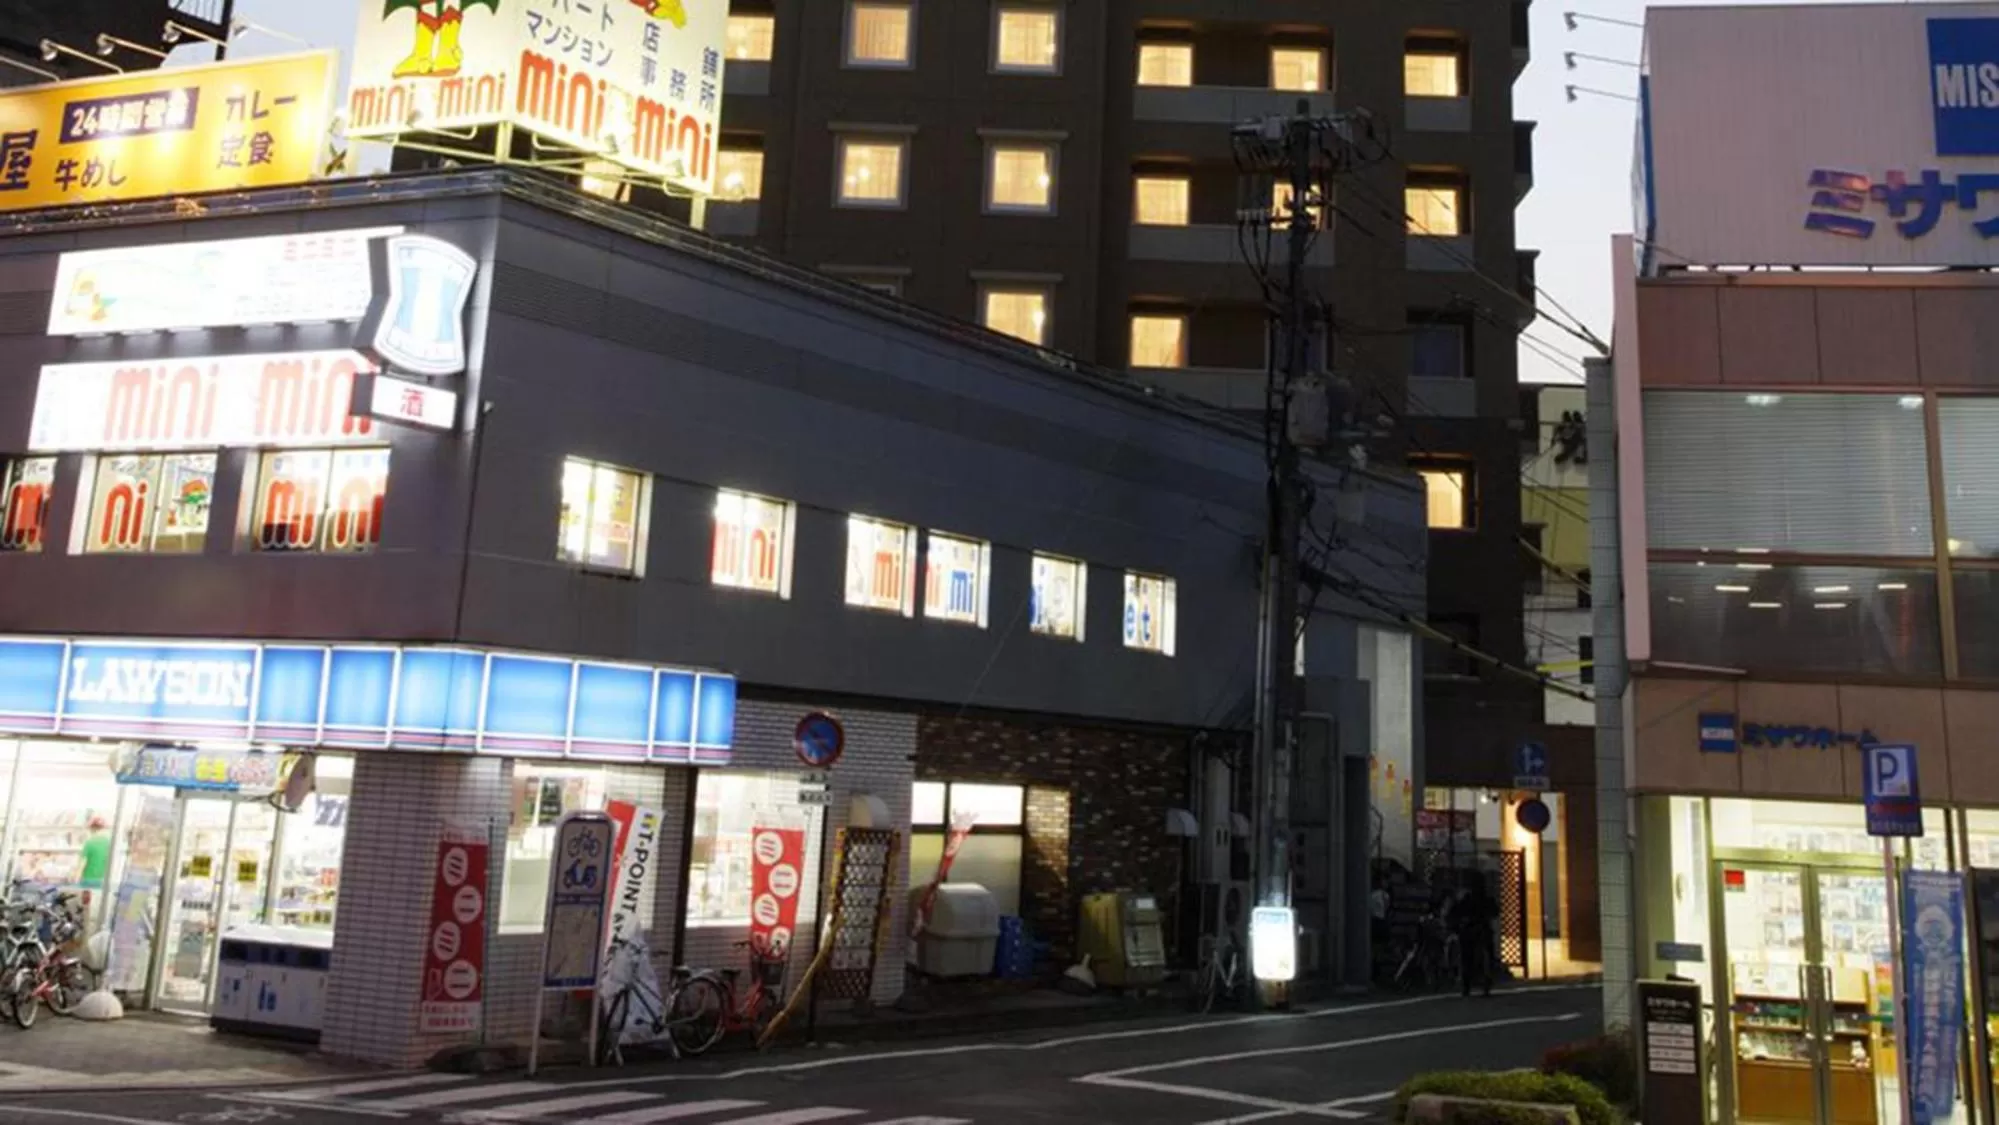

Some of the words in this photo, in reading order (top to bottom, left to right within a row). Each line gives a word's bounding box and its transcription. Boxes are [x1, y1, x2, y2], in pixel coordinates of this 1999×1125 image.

[525, 9, 614, 67] マンション
[225, 90, 297, 122] カレー
[349, 82, 416, 129] mini
[435, 73, 507, 118] mini
[1936, 63, 1999, 108] MIS
[516, 48, 608, 141] mini
[632, 95, 714, 182] mini
[216, 131, 275, 169] 定食
[53, 159, 128, 192] 牛めし
[103, 364, 220, 441] mini
[70, 658, 252, 707] LAWSON
[1877, 752, 1899, 793] P
